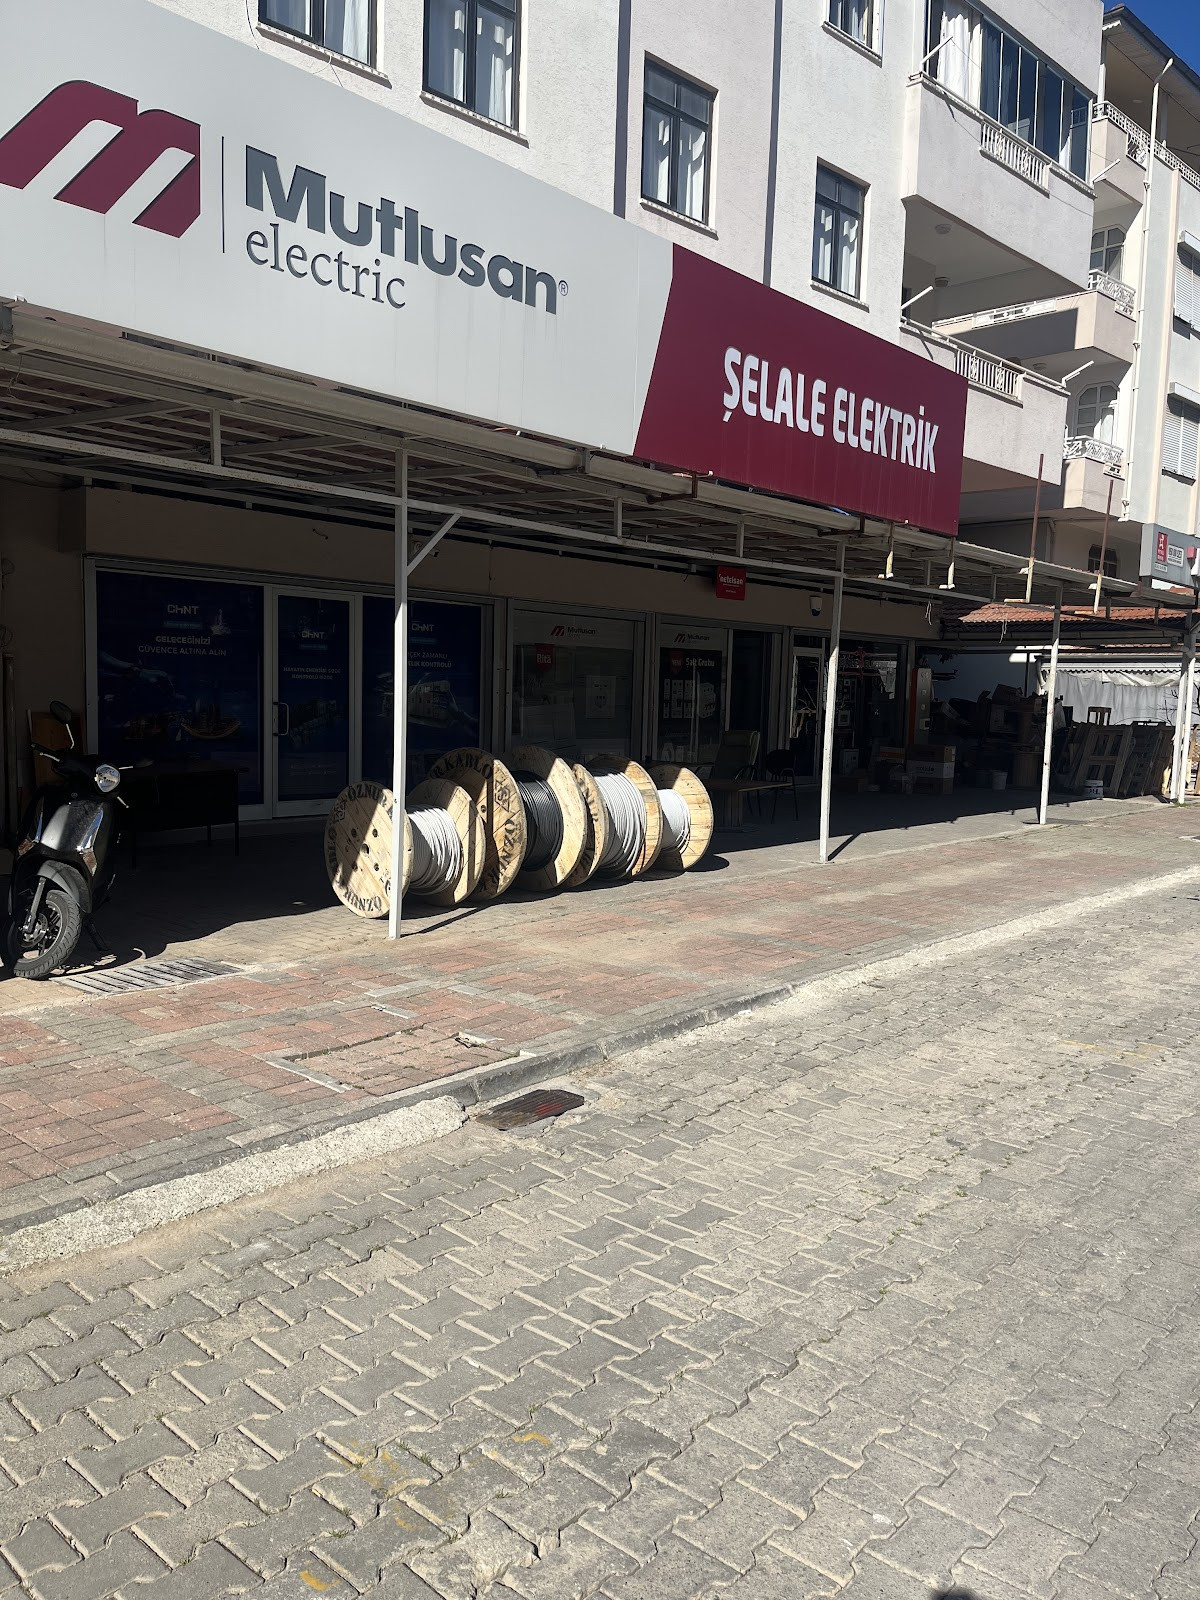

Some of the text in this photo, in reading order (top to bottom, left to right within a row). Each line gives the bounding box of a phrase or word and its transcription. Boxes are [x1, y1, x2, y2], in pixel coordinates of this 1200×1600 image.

[246, 223, 406, 309] electric
[722, 346, 939, 474] ŞELALE ELEKTRİK
